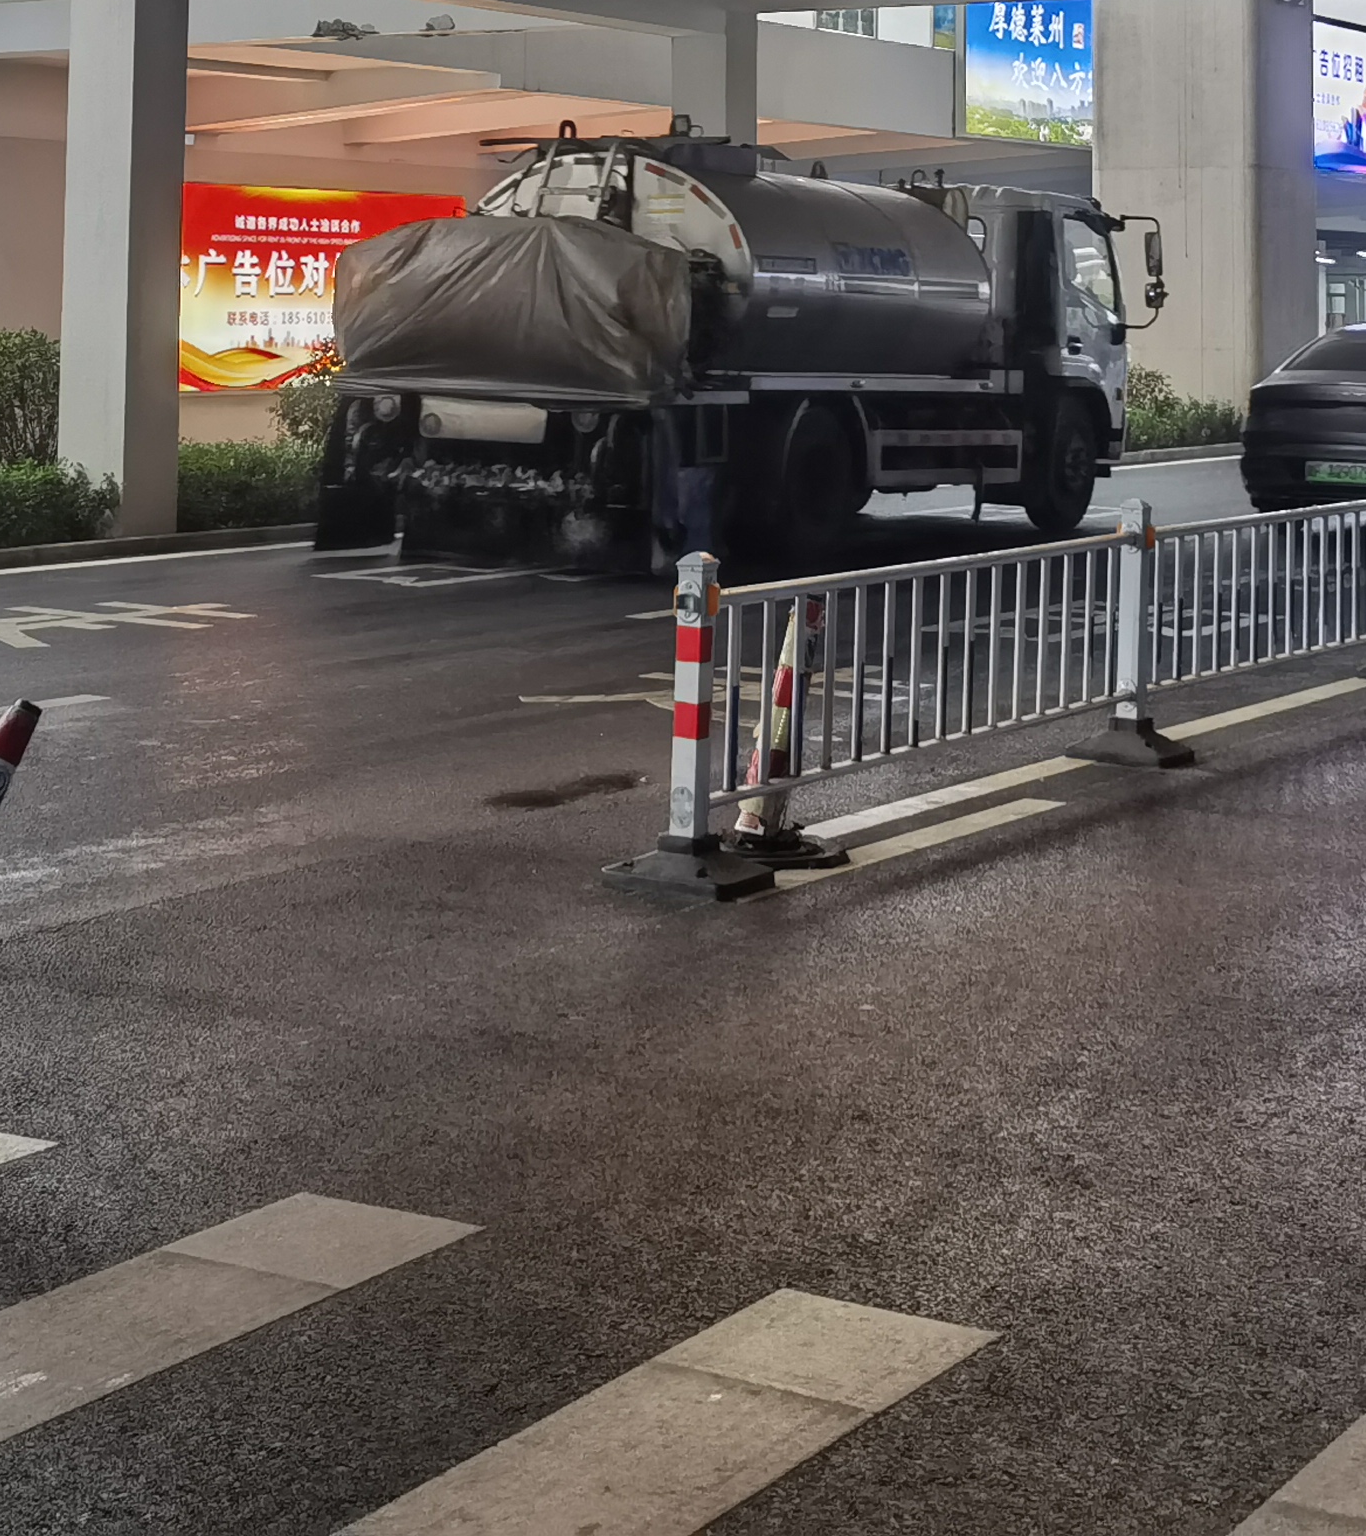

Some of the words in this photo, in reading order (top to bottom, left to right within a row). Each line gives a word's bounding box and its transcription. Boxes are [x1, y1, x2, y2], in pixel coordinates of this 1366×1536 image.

[989, 1, 1064, 49] 厚德莱州
[1314, 48, 1364, 83] 告位招租
[180, 249, 341, 298] 广告位对
